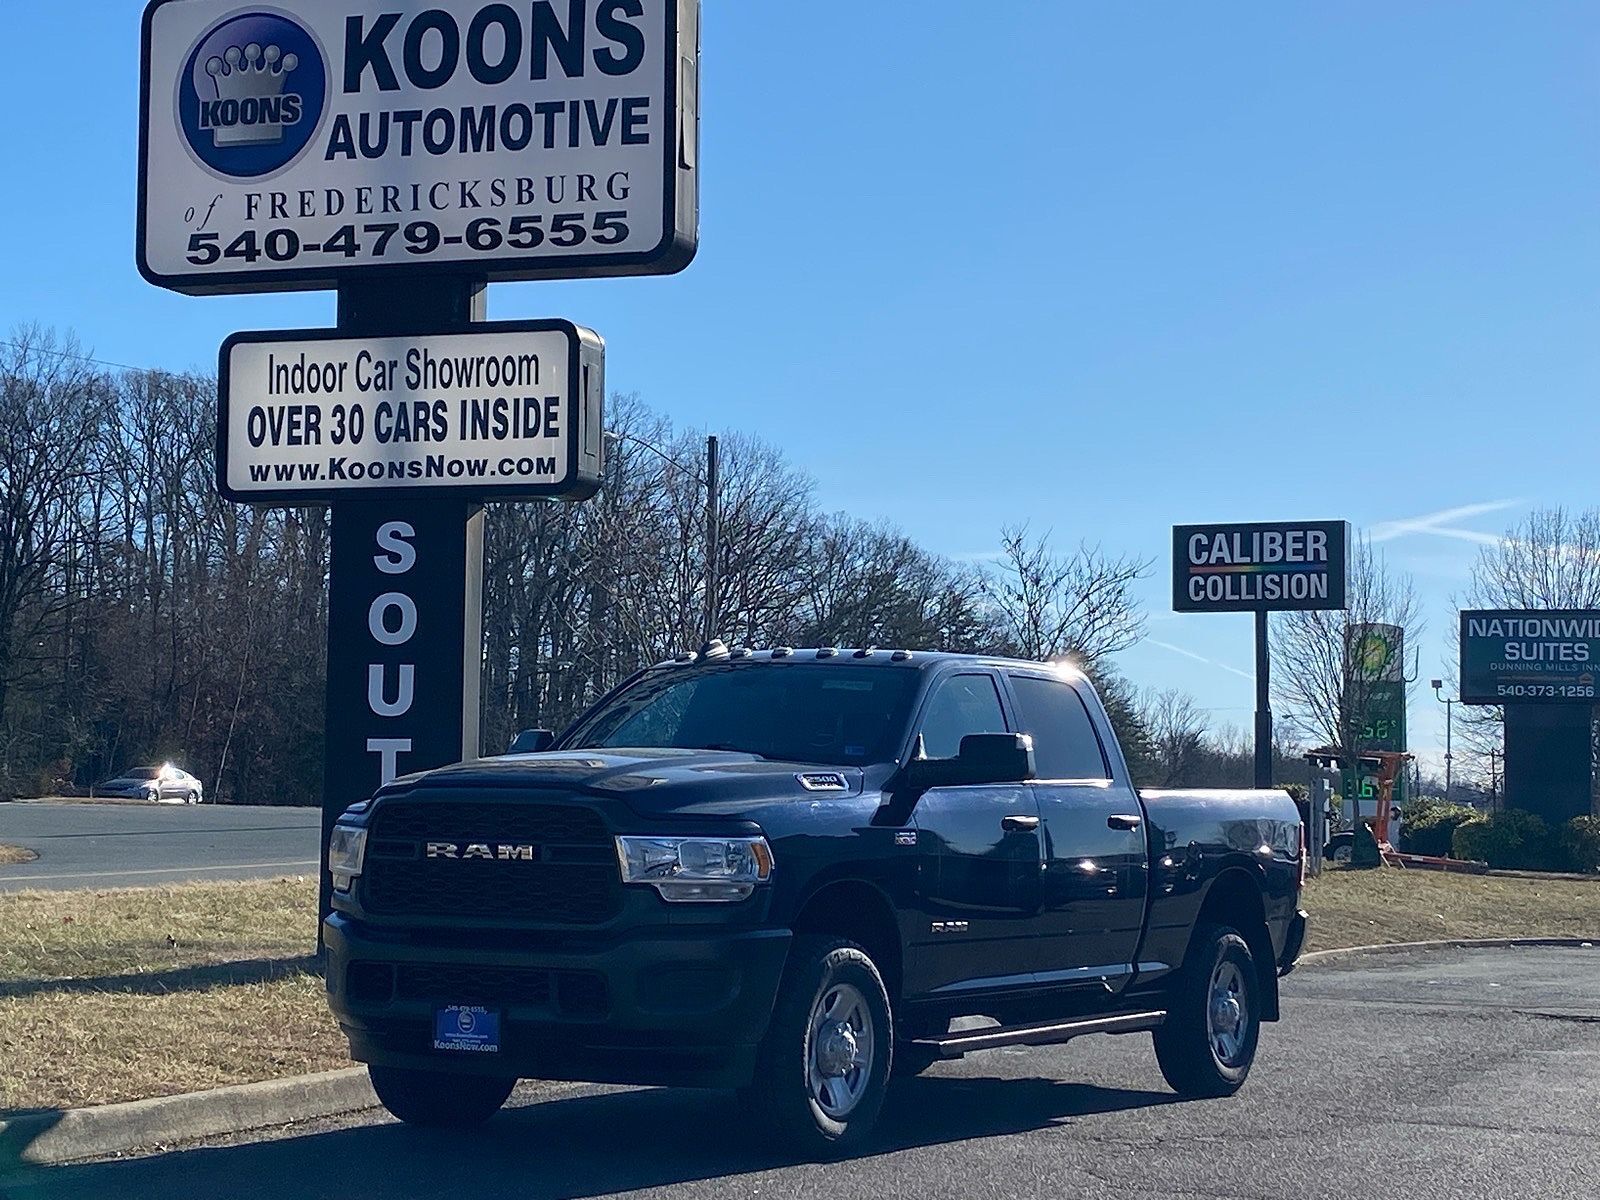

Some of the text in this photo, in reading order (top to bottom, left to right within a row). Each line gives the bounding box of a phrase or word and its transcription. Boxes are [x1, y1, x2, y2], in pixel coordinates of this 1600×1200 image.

[343, 0, 645, 93] KOONS
[200, 94, 302, 129] KOONS
[325, 97, 650, 161] AUTOMOTIVE
[184, 171, 631, 231] of FREDERICKSBURG
[186, 210, 630, 265] 540-479-6555
[268, 347, 539, 395] Indoor Car Showroom
[247, 396, 561, 448] OVER 30 CARS INSIDE
[1188, 530, 1328, 565] CALIBER
[1188, 573, 1328, 601] COLLISION
[1490, 662, 1542, 671] DUNNING
[1545, 663, 1578, 671] MILLS
[1504, 642, 1590, 661] SUITES
[1497, 685, 1595, 697] 540-373-1256
[427, 842, 533, 860] RAM
[931, 921, 969, 933] RAM
[434, 1040, 498, 1052] KoonsNow.com
